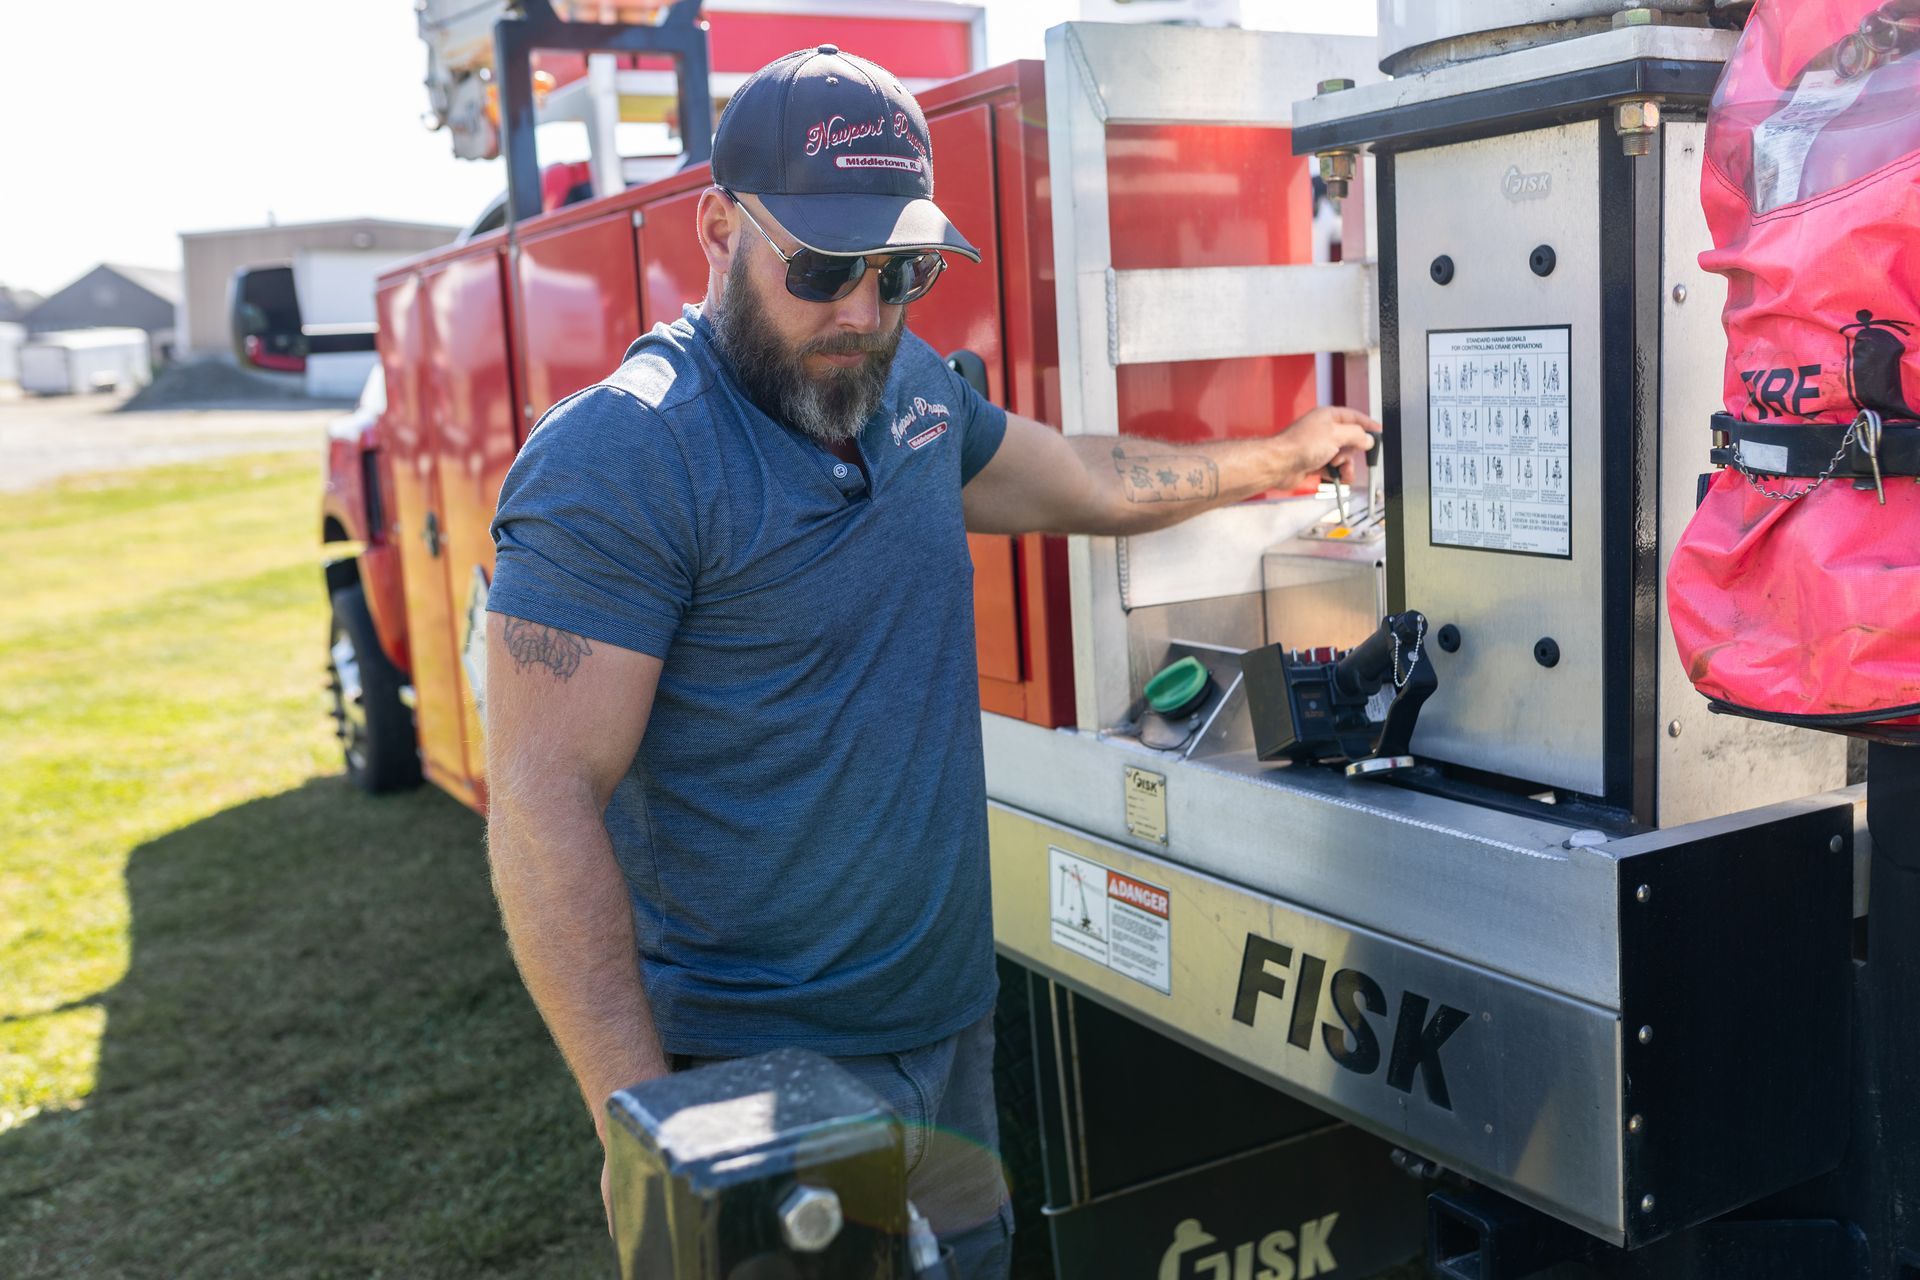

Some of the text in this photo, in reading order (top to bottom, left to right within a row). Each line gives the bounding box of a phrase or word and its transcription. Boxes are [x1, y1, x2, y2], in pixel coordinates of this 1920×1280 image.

[806, 115, 885, 156] Newport
[845, 155, 908, 169] Middletown,
[1462, 343, 1494, 351] CONTROLLING
[1512, 342, 1542, 350] OPERATIONS
[1466, 336, 1490, 344] STANDARD
[1118, 880, 1168, 914] DANGER
[1232, 931, 1471, 1112] FISK
